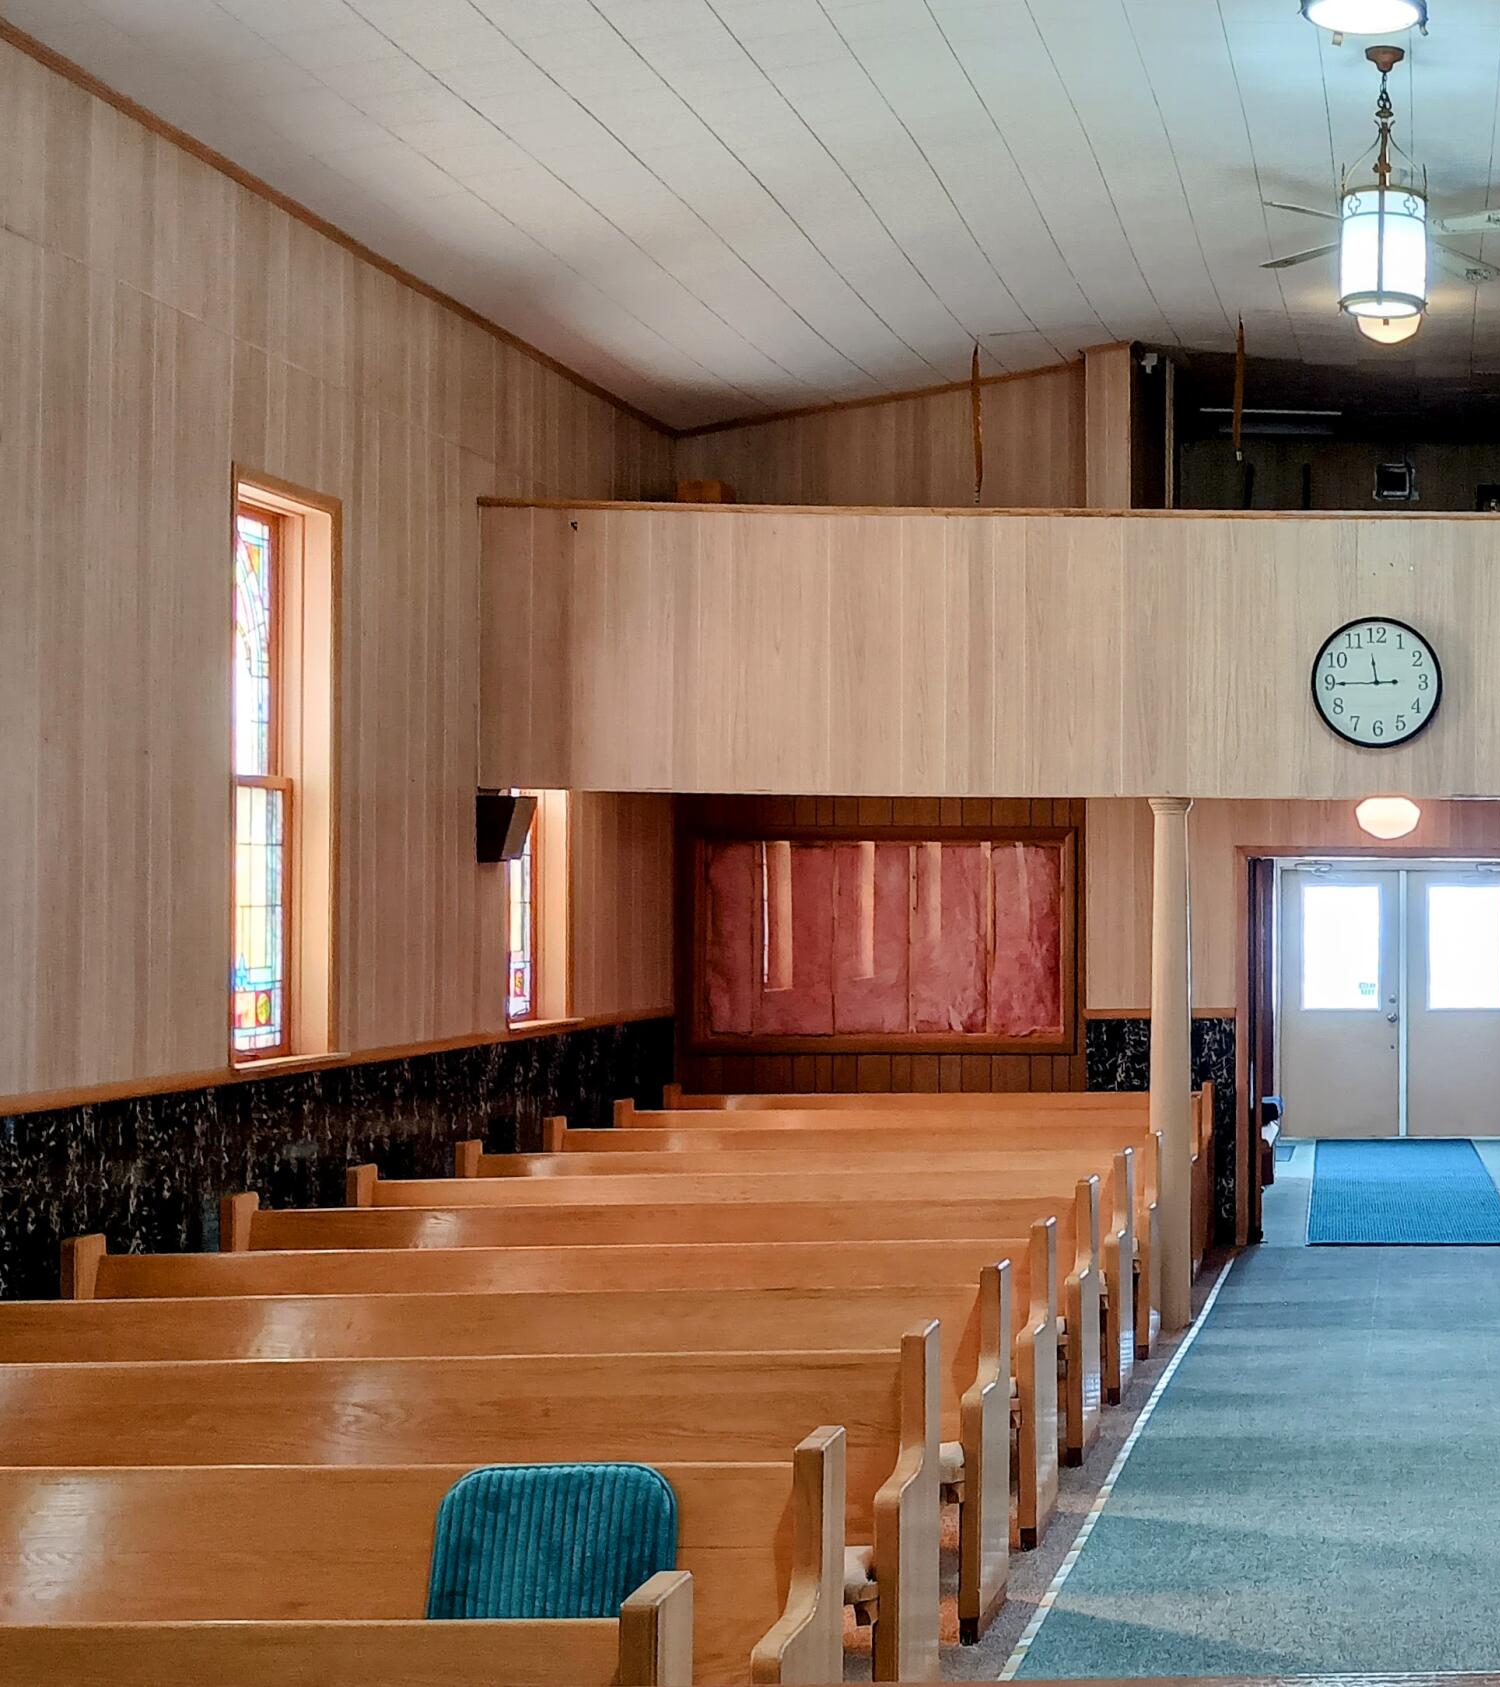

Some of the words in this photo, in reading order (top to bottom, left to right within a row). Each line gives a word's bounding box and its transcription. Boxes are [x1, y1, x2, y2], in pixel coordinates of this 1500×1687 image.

[1345, 633, 1363, 649] 11
[1366, 627, 1386, 644] 12
[1396, 634, 1404, 649] 1
[1327, 652, 1347, 668] 10
[1412, 651, 1422, 667] 2
[1325, 674, 1335, 691] 9
[1418, 674, 1428, 690] 3
[1333, 698, 1344, 714] 8
[1411, 698, 1421, 713] 4
[1350, 716, 1360, 732] 7
[1373, 720, 1383, 737] 6
[1395, 715, 1406, 731] 5
